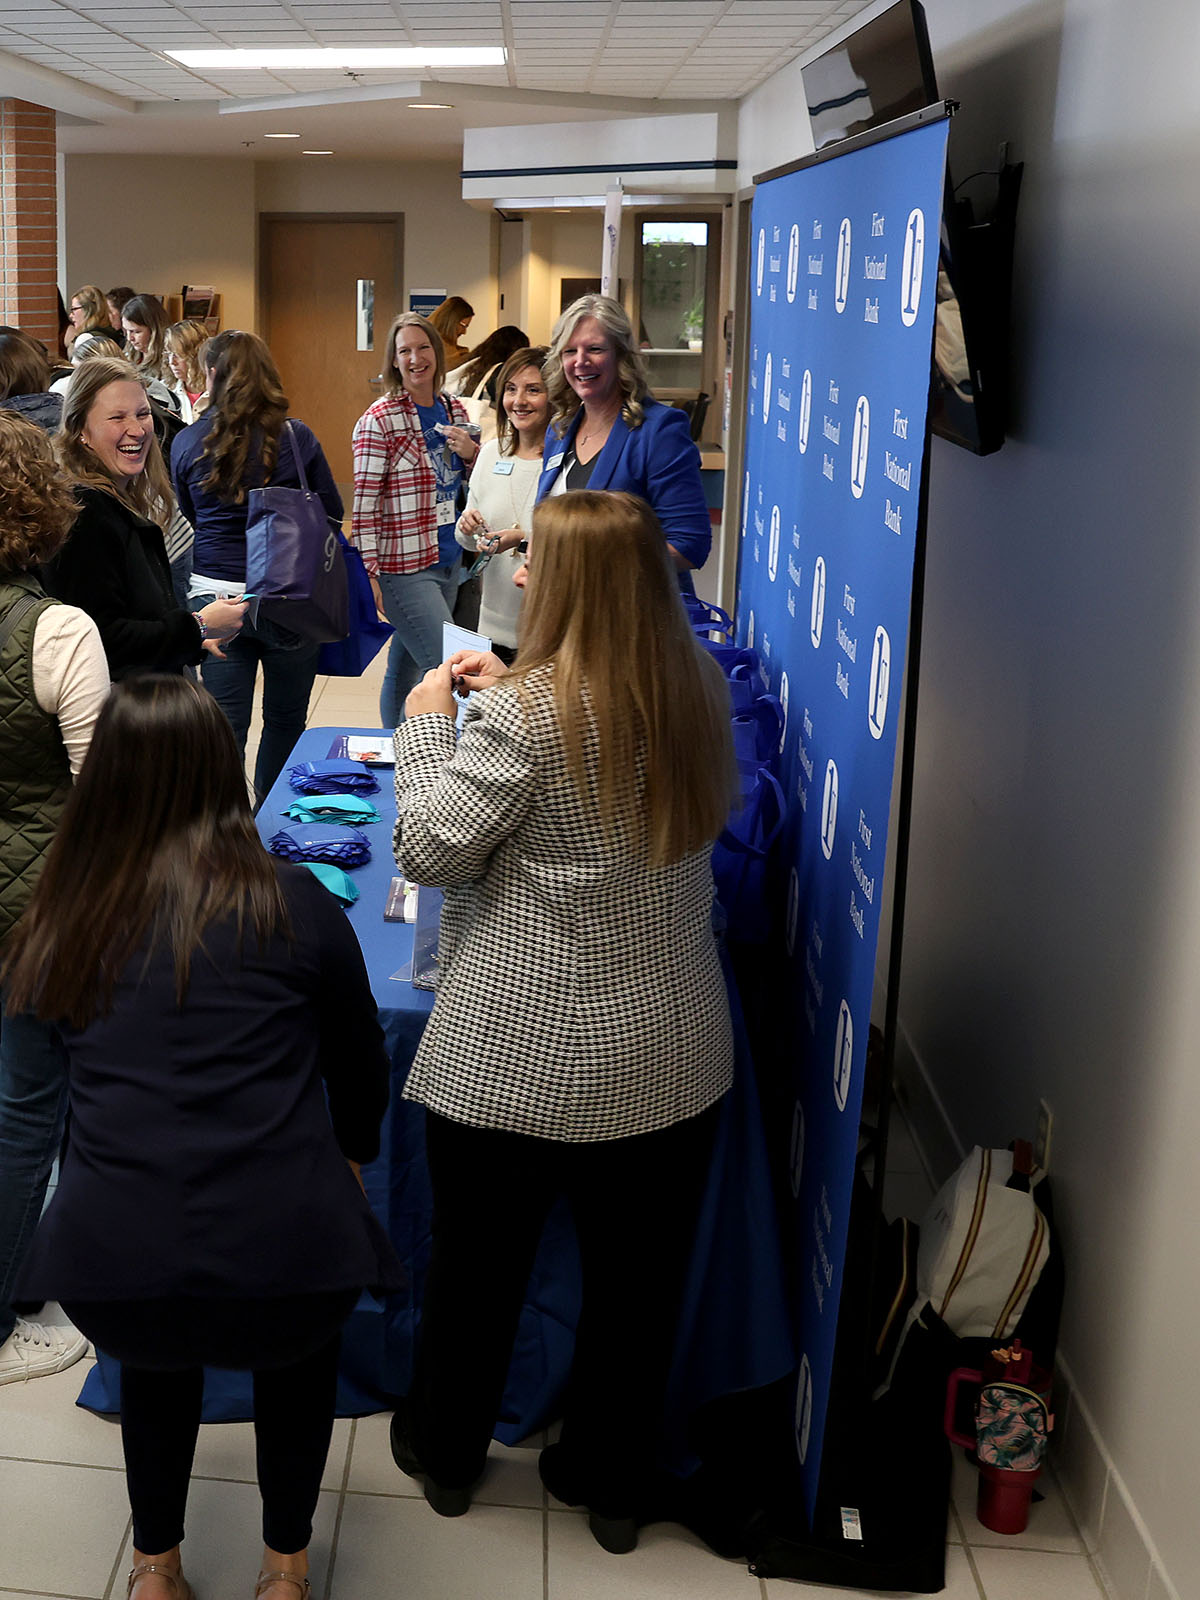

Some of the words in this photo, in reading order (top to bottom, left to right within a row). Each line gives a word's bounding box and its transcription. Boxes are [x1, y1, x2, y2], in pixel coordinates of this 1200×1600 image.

[893, 408, 909, 440] First
[883, 451, 912, 491] National
[884, 498, 902, 535] Bank
